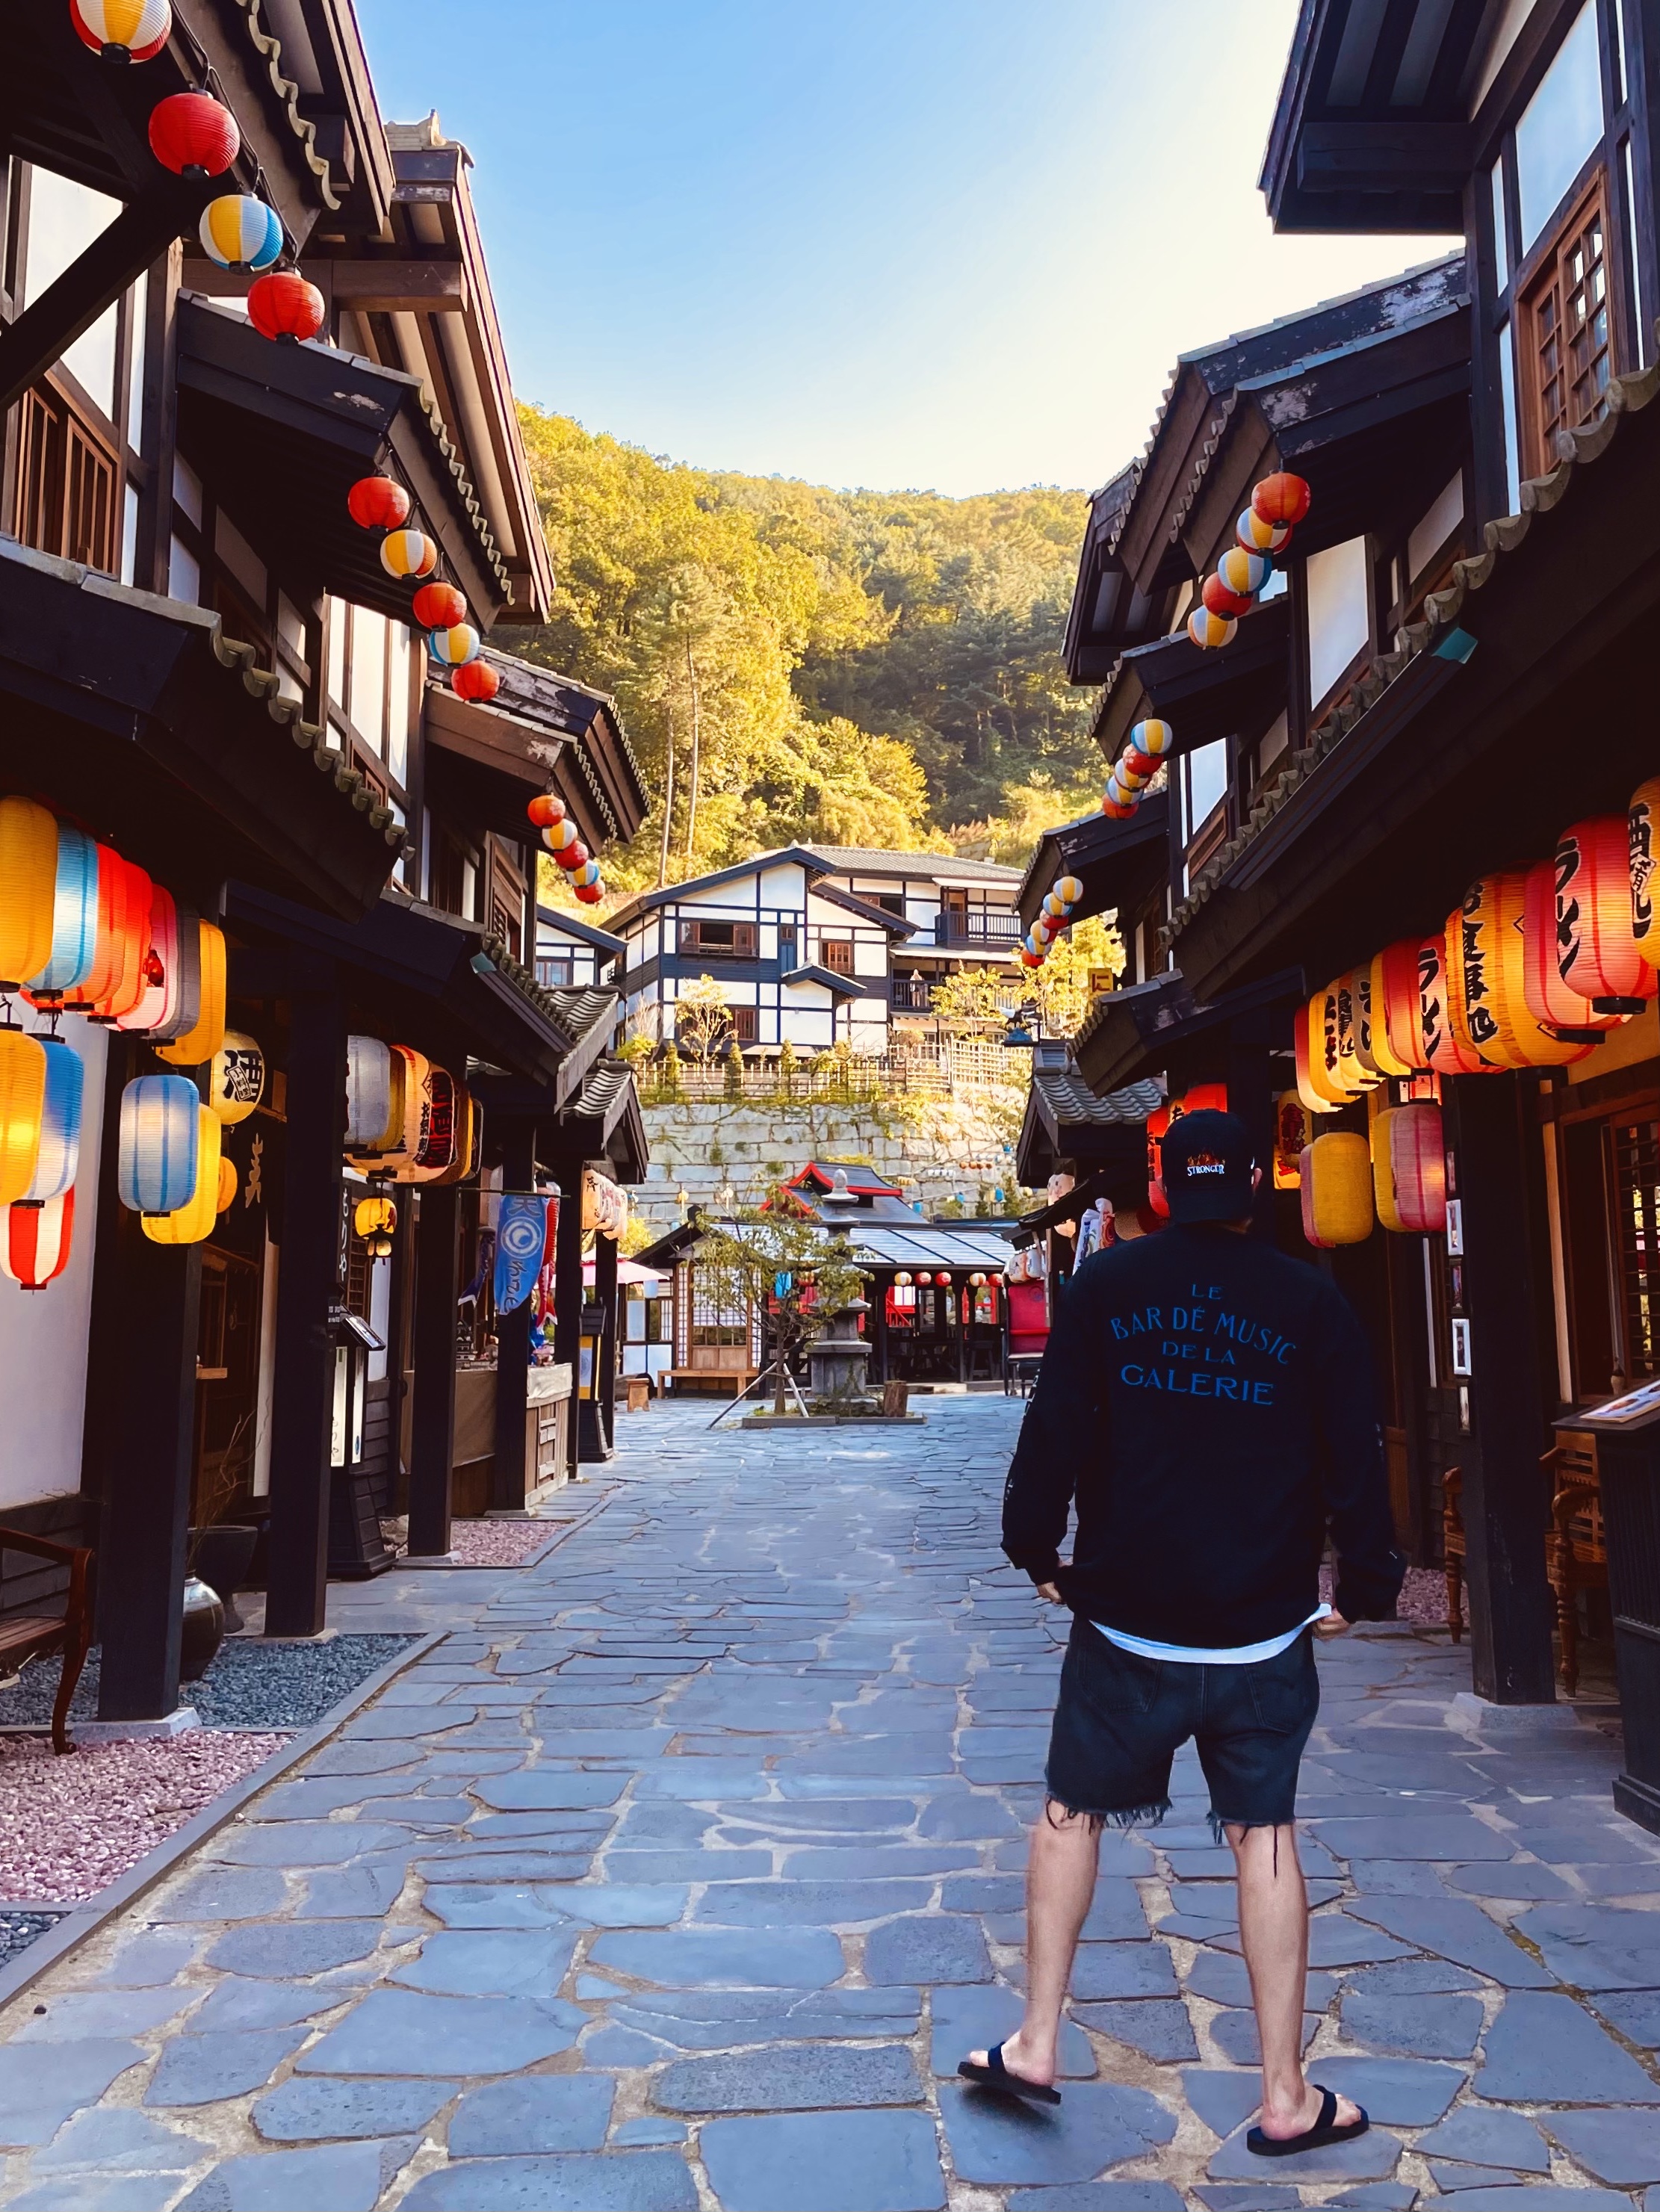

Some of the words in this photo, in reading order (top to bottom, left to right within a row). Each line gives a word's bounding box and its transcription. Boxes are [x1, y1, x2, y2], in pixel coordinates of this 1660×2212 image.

[1186, 1164, 1225, 1177] STRONGER
[1191, 1283, 1224, 1300] LE
[1110, 1307, 1163, 1339] BAR
[1213, 1313, 1296, 1365] MUSIC
[1162, 1341, 1198, 1359] DE
[1205, 1348, 1236, 1366] LA
[1120, 1364, 1275, 1405] GALERIE
